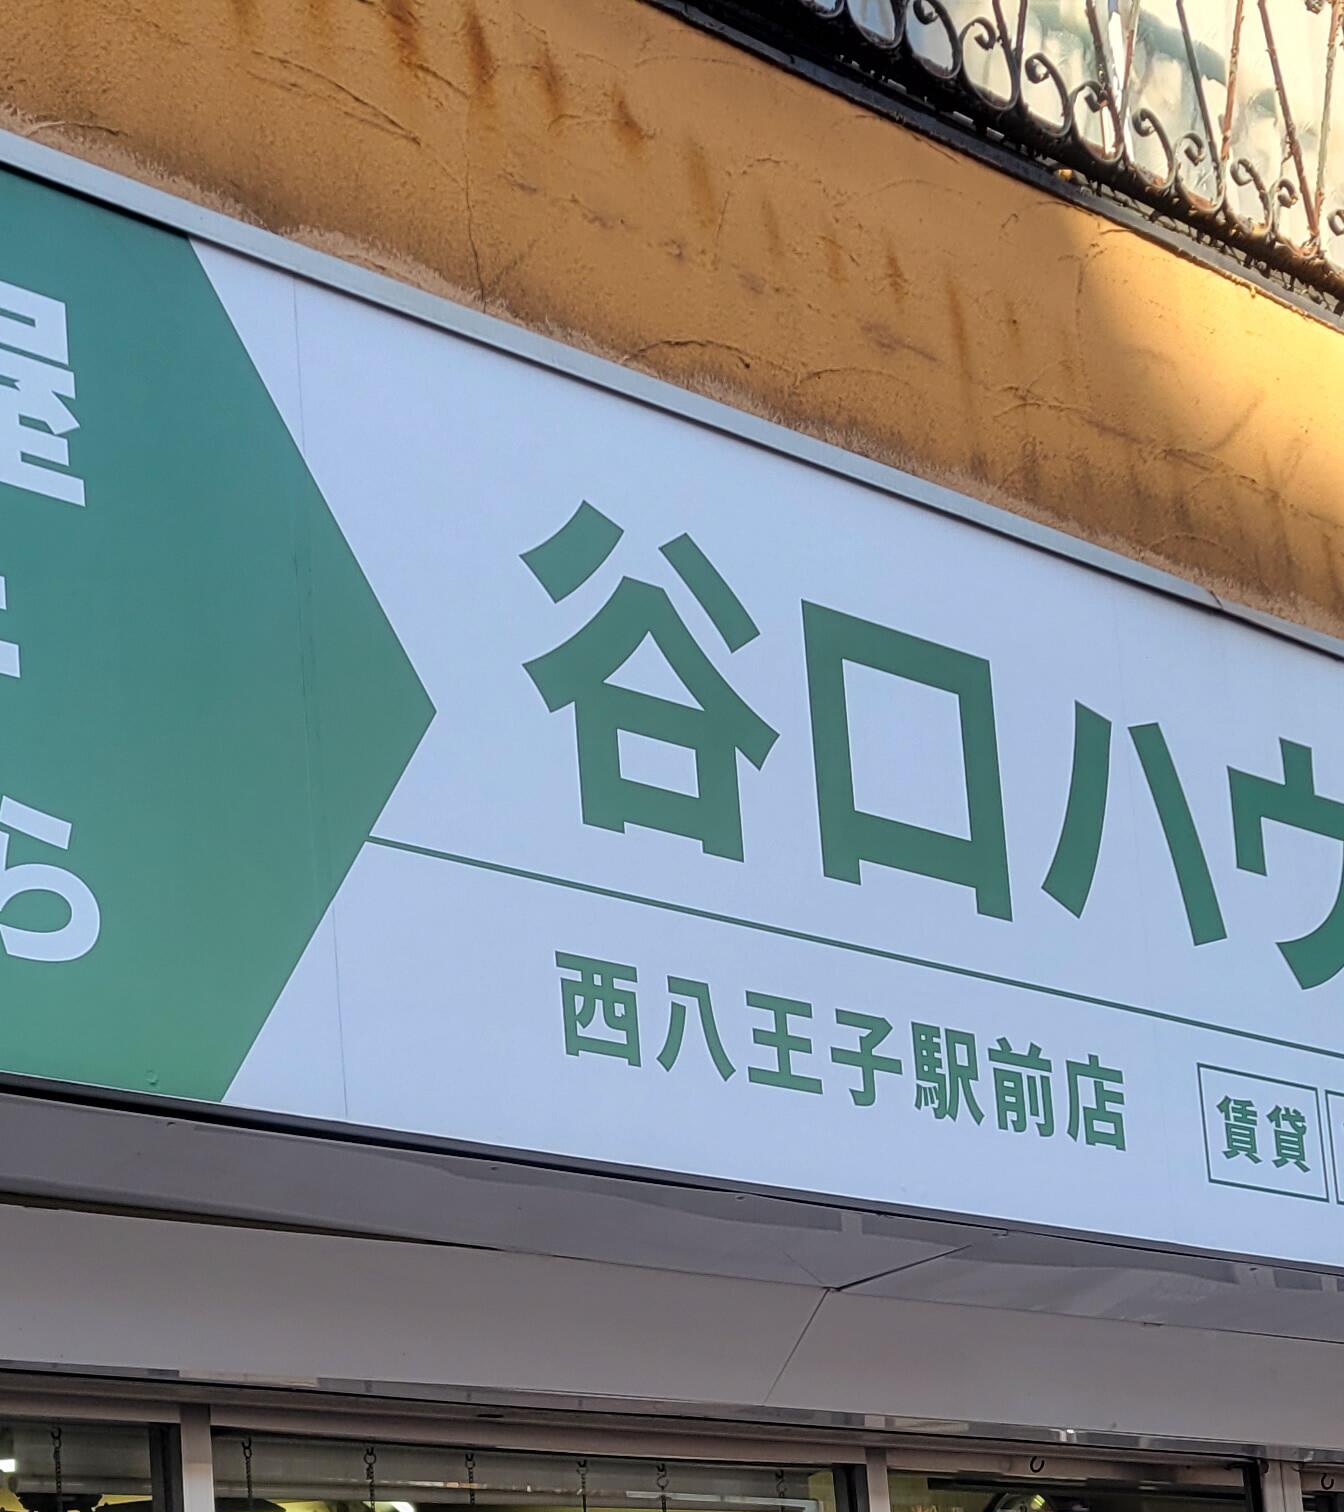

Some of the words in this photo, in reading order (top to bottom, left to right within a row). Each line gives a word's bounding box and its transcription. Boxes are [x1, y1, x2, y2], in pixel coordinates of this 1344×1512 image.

[554, 950, 1127, 1151] 西八王子駅前店
[1216, 1095, 1311, 1174] 賃貸
